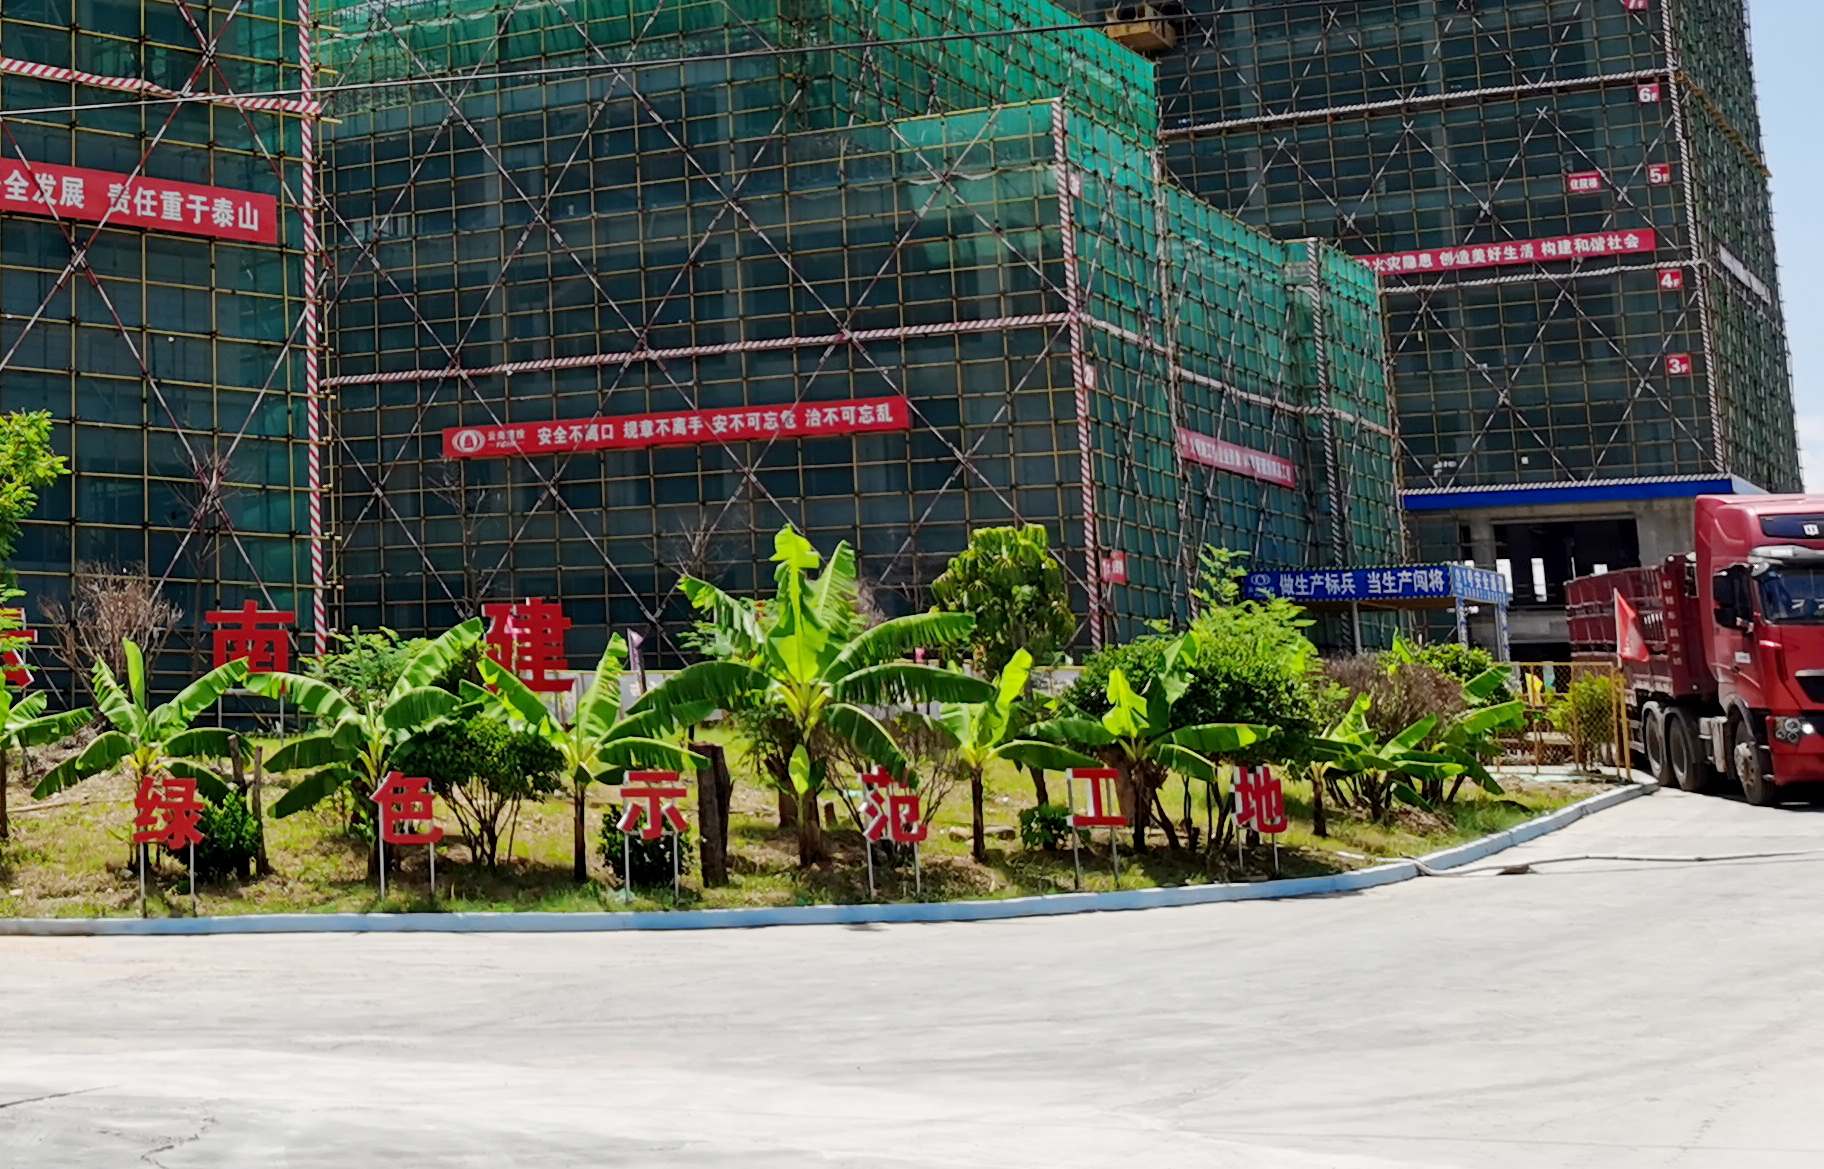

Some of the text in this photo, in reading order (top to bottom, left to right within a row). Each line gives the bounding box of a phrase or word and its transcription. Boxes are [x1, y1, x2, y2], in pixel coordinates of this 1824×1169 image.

[1650, 168, 1670, 183] 5F
[107, 183, 259, 231] 责任重于泰山
[1660, 274, 1680, 288] 4F
[1669, 359, 1688, 374] 3F
[537, 423, 614, 446] 安全不离口
[712, 410, 797, 434] 安不可忘危
